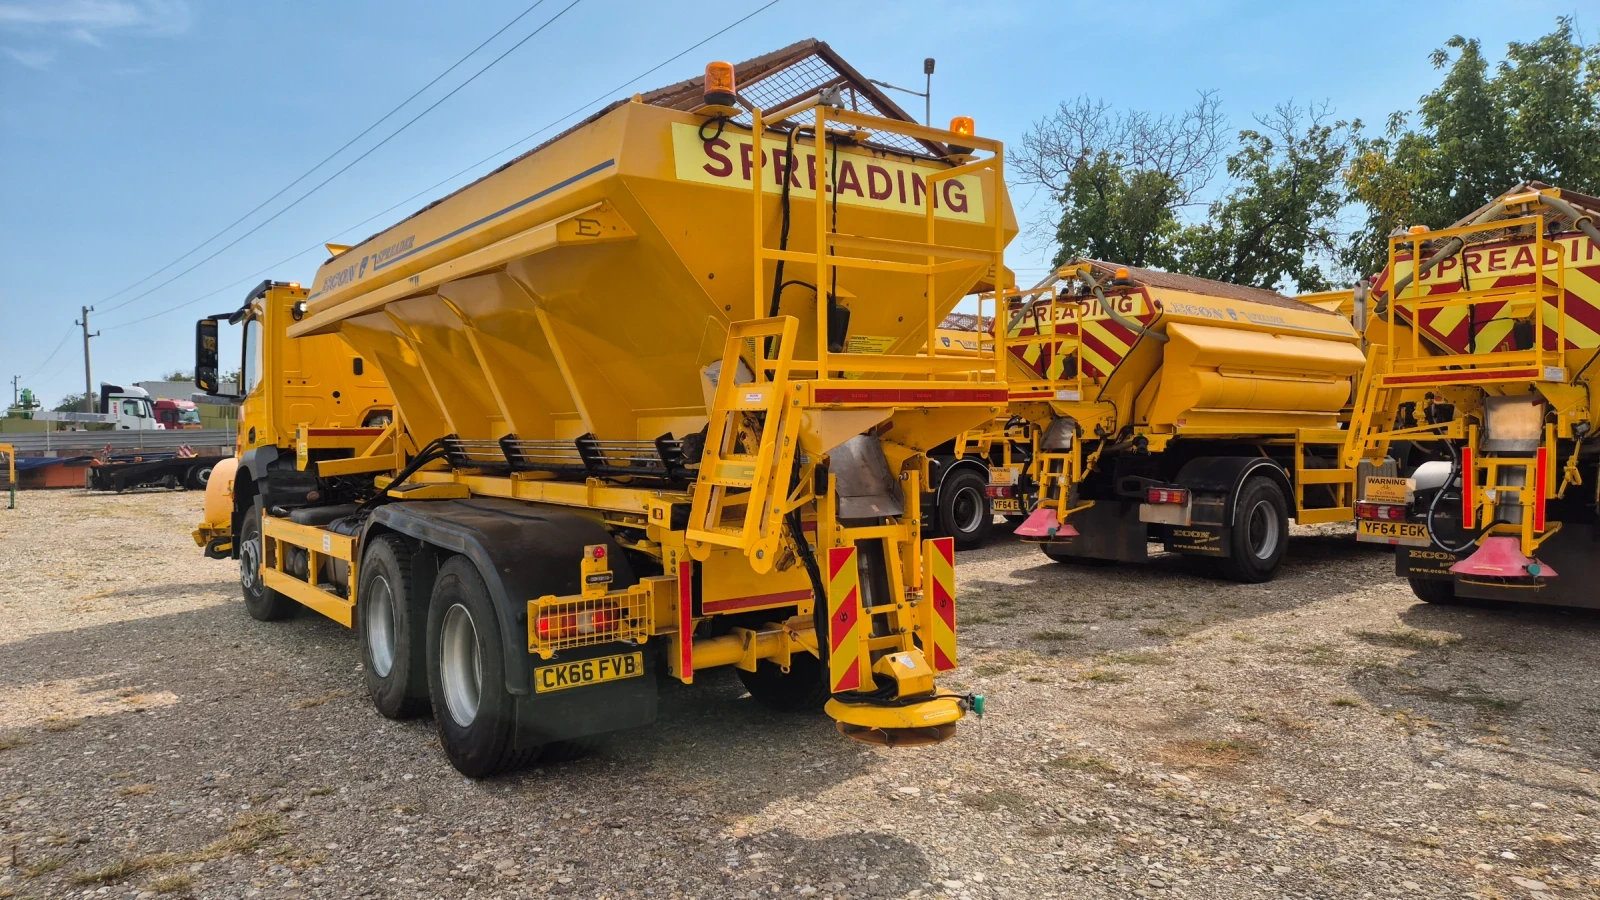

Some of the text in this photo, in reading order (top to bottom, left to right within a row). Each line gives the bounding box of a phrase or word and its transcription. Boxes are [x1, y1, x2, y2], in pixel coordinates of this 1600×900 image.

[702, 138, 969, 213] SPREADING
[1367, 477, 1406, 486] WARNING
[994, 500, 1012, 509] YF64
[1365, 521, 1425, 537] YF64 EGK
[542, 655, 636, 689] CK66 FVB
